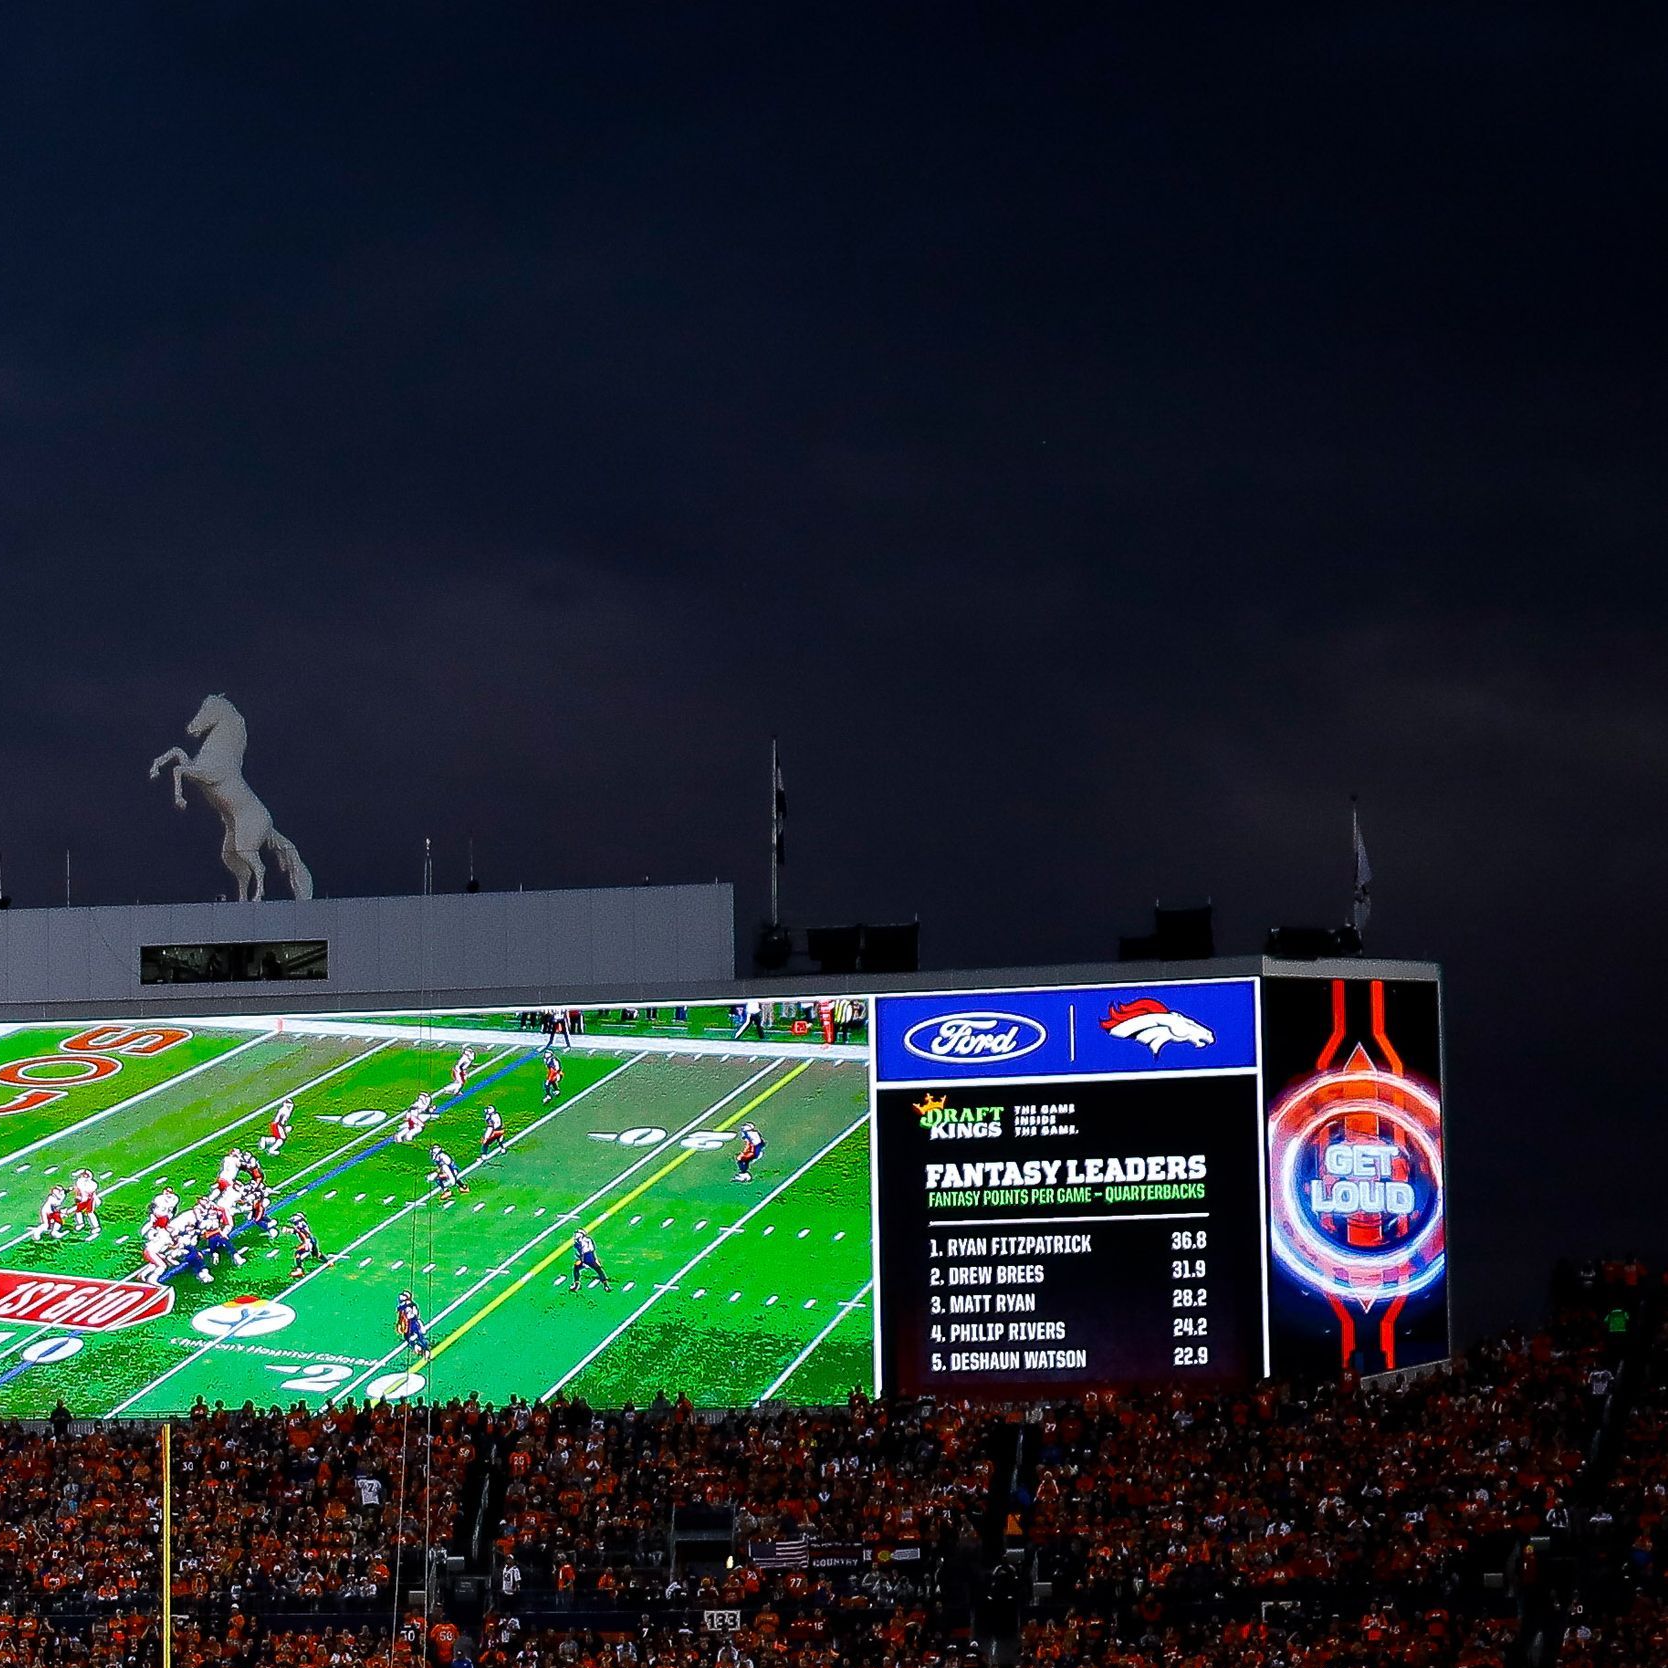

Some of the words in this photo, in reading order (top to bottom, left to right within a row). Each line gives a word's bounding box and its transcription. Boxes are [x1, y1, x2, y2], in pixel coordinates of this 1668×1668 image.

[930, 1018, 1020, 1055] Ford
[920, 1106, 1005, 1128] DRAFT
[1015, 1106, 1037, 1115] THE
[1040, 1104, 1075, 1114] GAME
[929, 1122, 1002, 1140] KINGS
[1015, 1127, 1037, 1137] THE
[925, 1160, 1062, 1189] FANTASY
[1066, 1154, 1207, 1184] LEADERS
[1325, 1143, 1400, 1177] GET
[928, 1190, 981, 1208] FANTASY
[983, 1188, 1028, 1207] POINTS
[1031, 1188, 1055, 1205] PER
[1056, 1187, 1092, 1204] GAME
[1105, 1183, 1206, 1203] QUARTERBACKS
[1310, 1178, 1416, 1216] LOUD
[929, 1238, 944, 1258] 1.
[947, 1238, 987, 1258] RYAN
[991, 1235, 1092, 1256] FITZPATRICK
[1171, 1231, 1207, 1251] 36.8
[929, 1267, 945, 1287] 2.
[948, 1266, 993, 1286] DREW
[996, 1264, 1045, 1285] BREES
[1171, 1259, 1206, 1279] 31.9
[931, 1296, 946, 1314] 3.
[949, 1294, 993, 1314] MATT
[995, 1293, 1036, 1313] RYAN
[1172, 1288, 1208, 1308] 28.2
[931, 1324, 946, 1343] 4.
[950, 1322, 1005, 1343] PHILIP
[1008, 1321, 1066, 1342] RIVERS
[1173, 1317, 1208, 1337] 24.2
[931, 1352, 946, 1372] 5.
[951, 1351, 1021, 1372] DESHAUN
[1024, 1349, 1087, 1370] WATSON
[1173, 1346, 1209, 1367] 22.9
